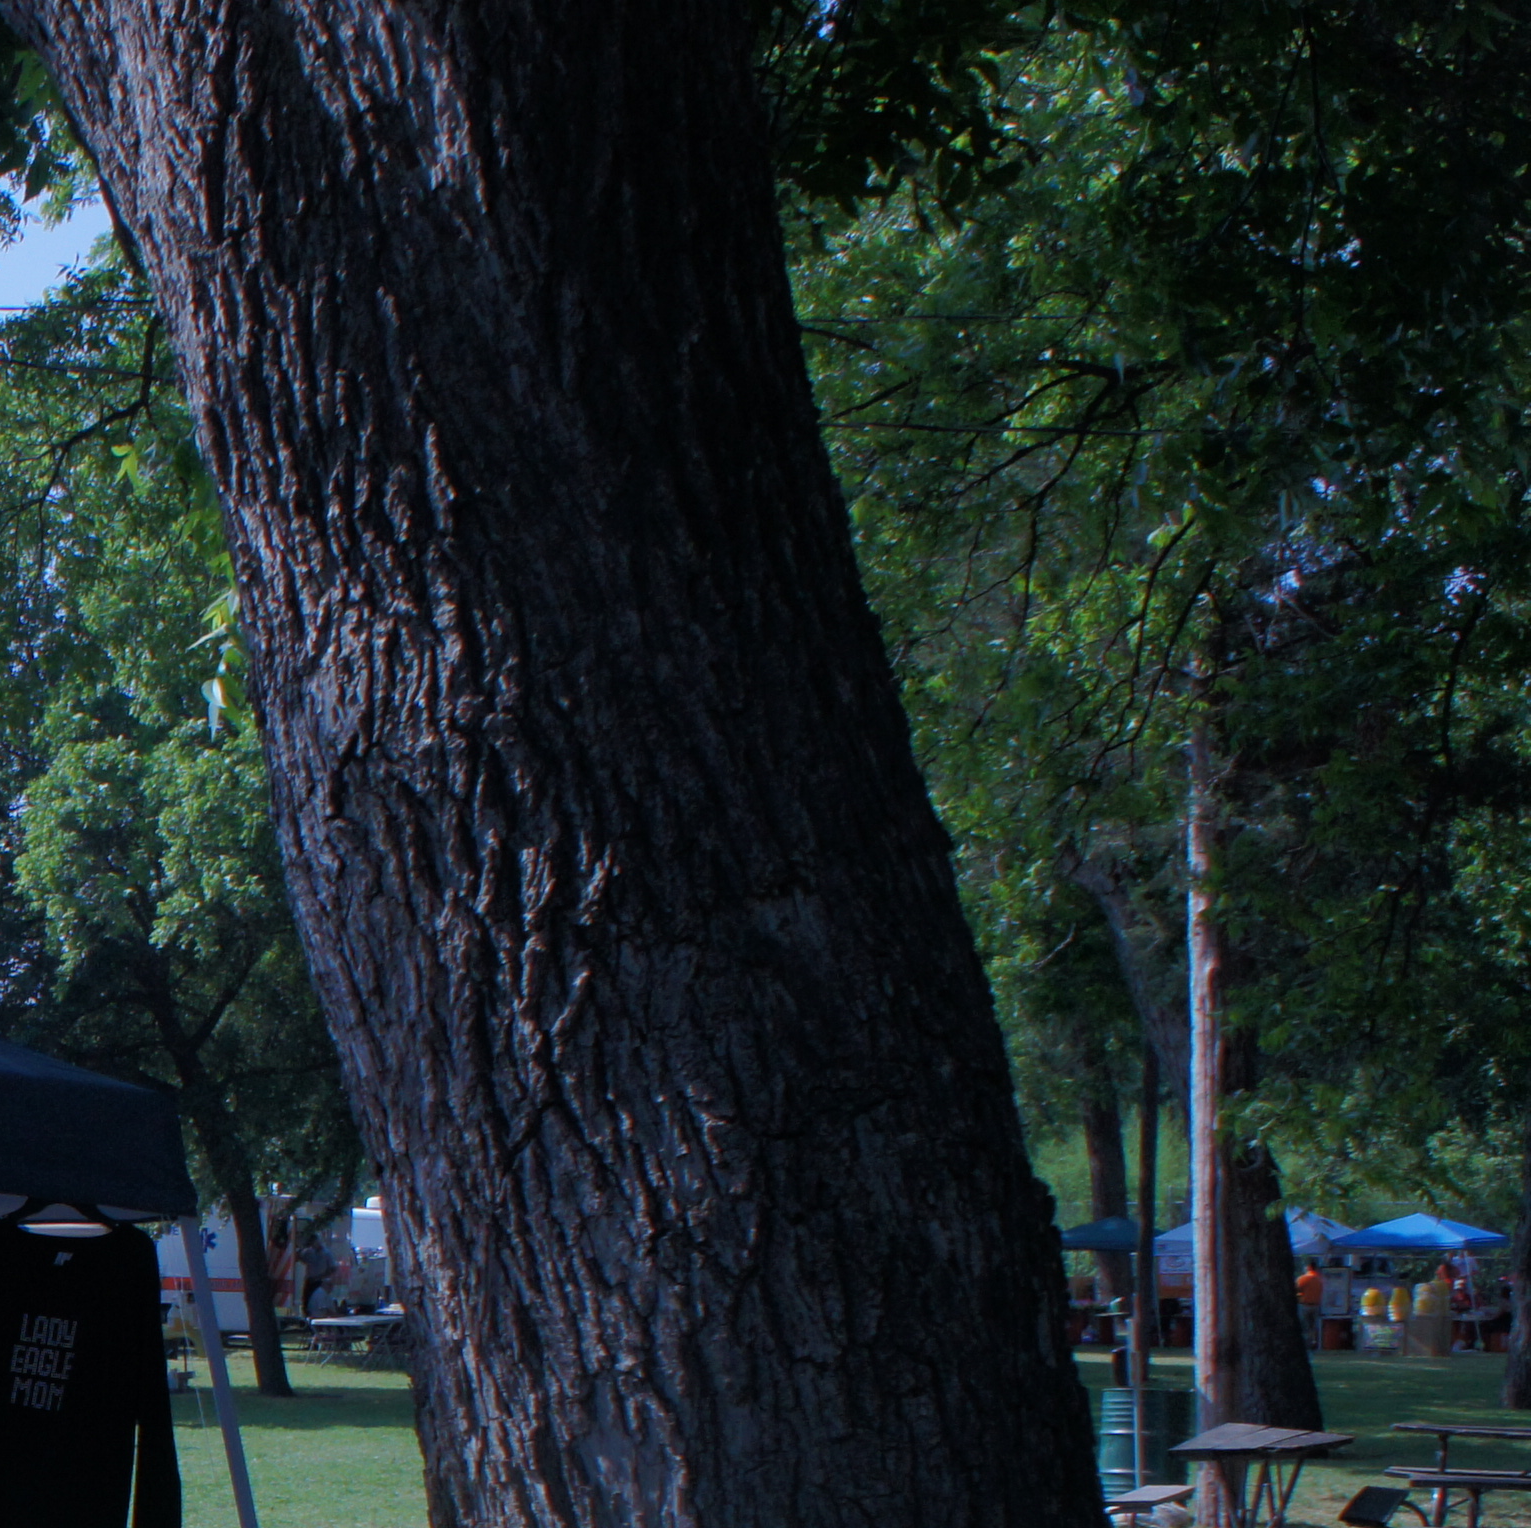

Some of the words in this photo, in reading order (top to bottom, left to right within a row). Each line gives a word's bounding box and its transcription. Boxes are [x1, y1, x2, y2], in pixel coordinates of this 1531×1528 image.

[19, 1313, 78, 1349] LADY
[9, 1344, 76, 1380] EAGLE
[10, 1376, 65, 1412] MOM
